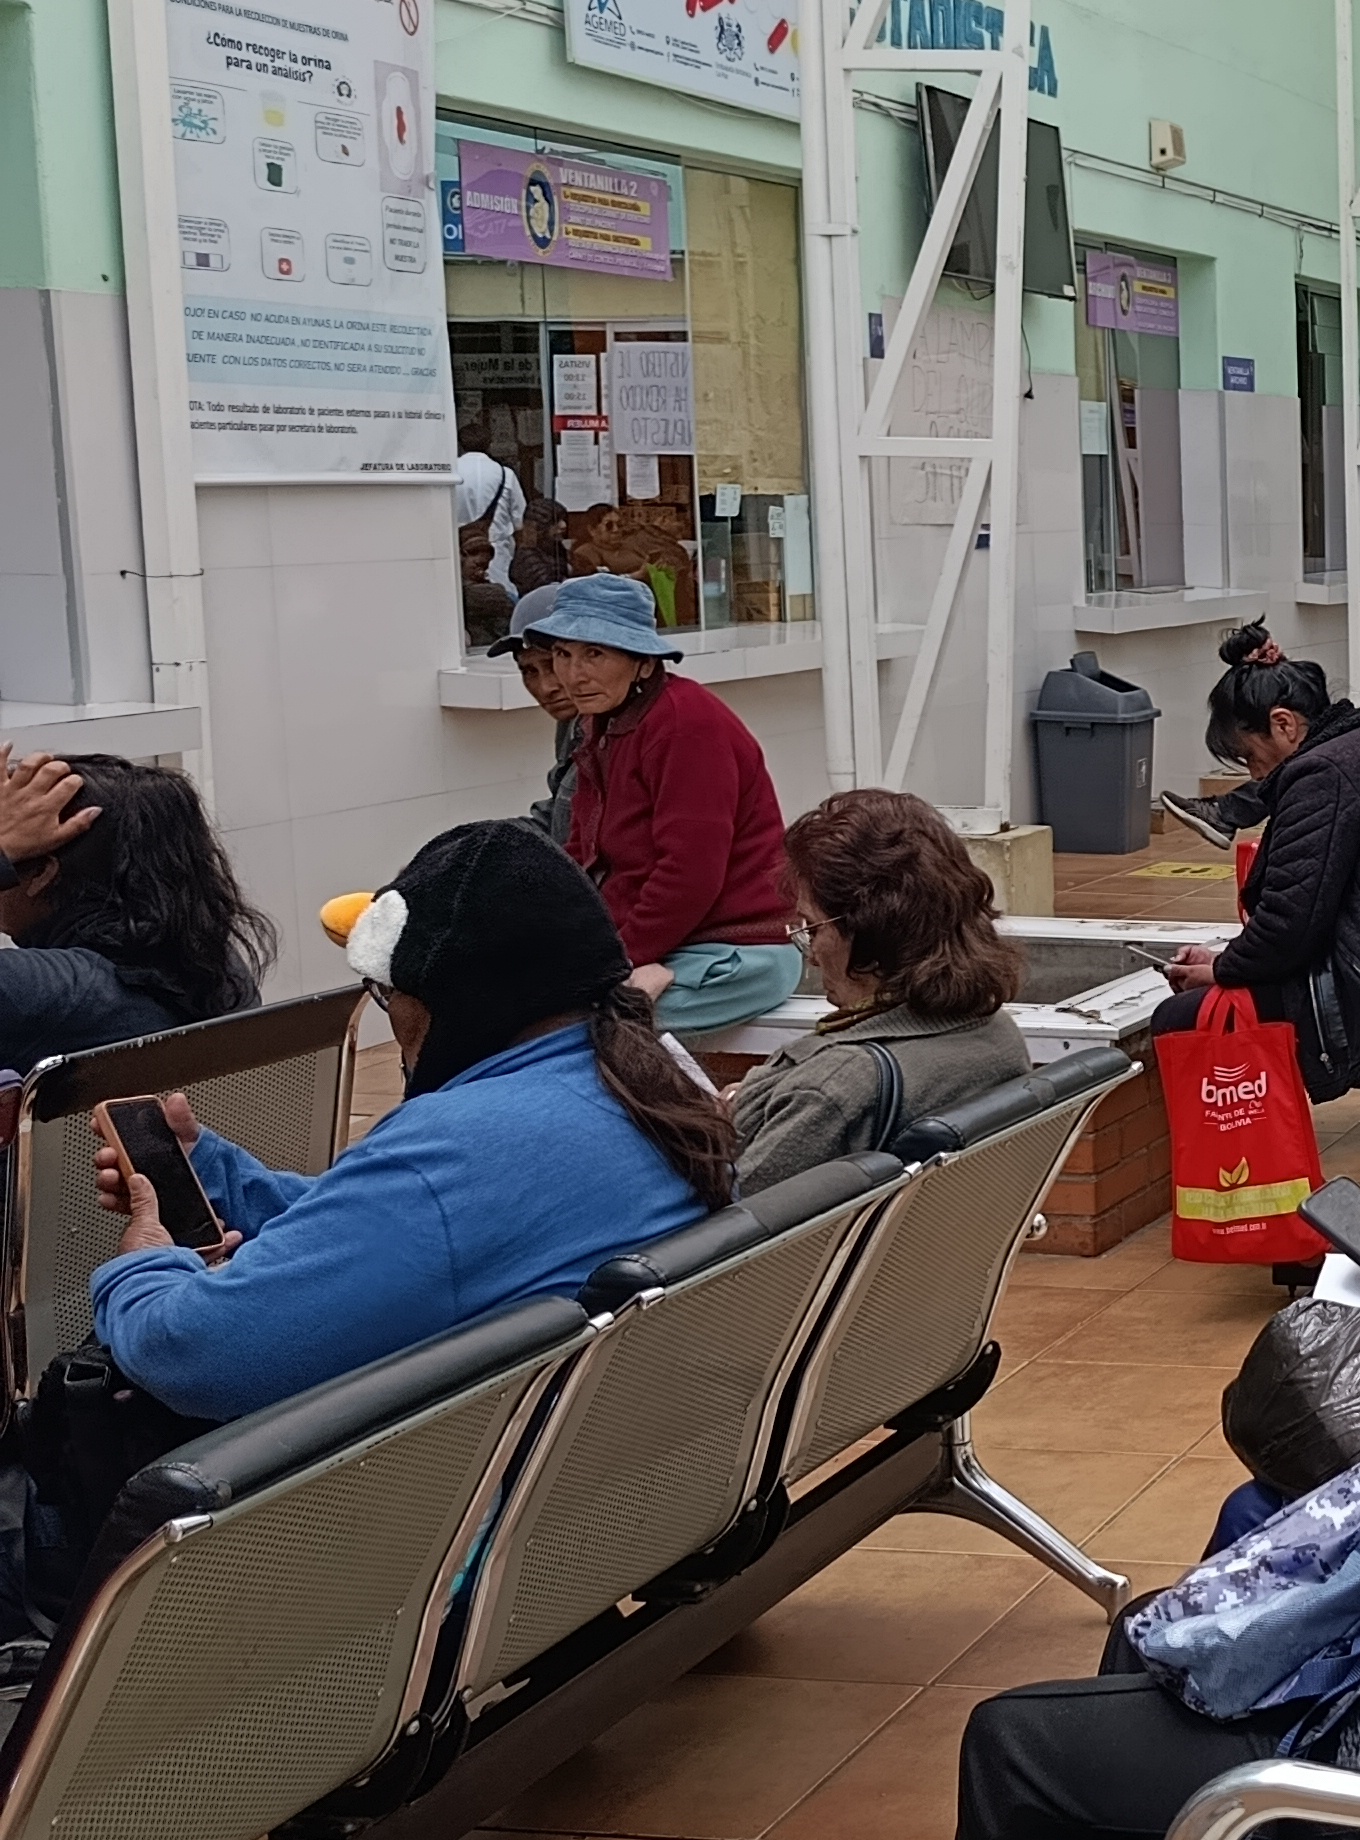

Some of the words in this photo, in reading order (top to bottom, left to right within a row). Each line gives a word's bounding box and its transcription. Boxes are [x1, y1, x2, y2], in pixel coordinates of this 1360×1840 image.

[584, 13, 627, 38] AGEMED
[206, 31, 242, 51] ¿Cómo
[245, 42, 286, 63] recoger
[289, 50, 298, 64] la
[301, 55, 332, 71] orina
[226, 55, 252, 71] para
[256, 62, 269, 74] un
[559, 167, 628, 196] VENTANILLA
[629, 180, 638, 197] 2
[466, 190, 520, 215] ADMISIÓN
[207, 308, 219, 319] EN
[221, 310, 247, 321] CASO
[251, 312, 262, 322] NO
[264, 314, 290, 325] ACUDA
[291, 316, 301, 326] EN
[334, 319, 345, 330] LA
[346, 320, 371, 332] ORINA
[192, 330, 205, 340] DE
[207, 331, 244, 343] MANERA
[222, 355, 241, 365] CON
[243, 356, 260, 366] LOS
[261, 357, 288, 368] DATOS
[334, 362, 346, 372] NO
[206, 401, 225, 412] Todo
[228, 403, 259, 413] resultado
[360, 463, 394, 471] JEFATURA
[1220, 1117, 1252, 1131] BOLIVIA
